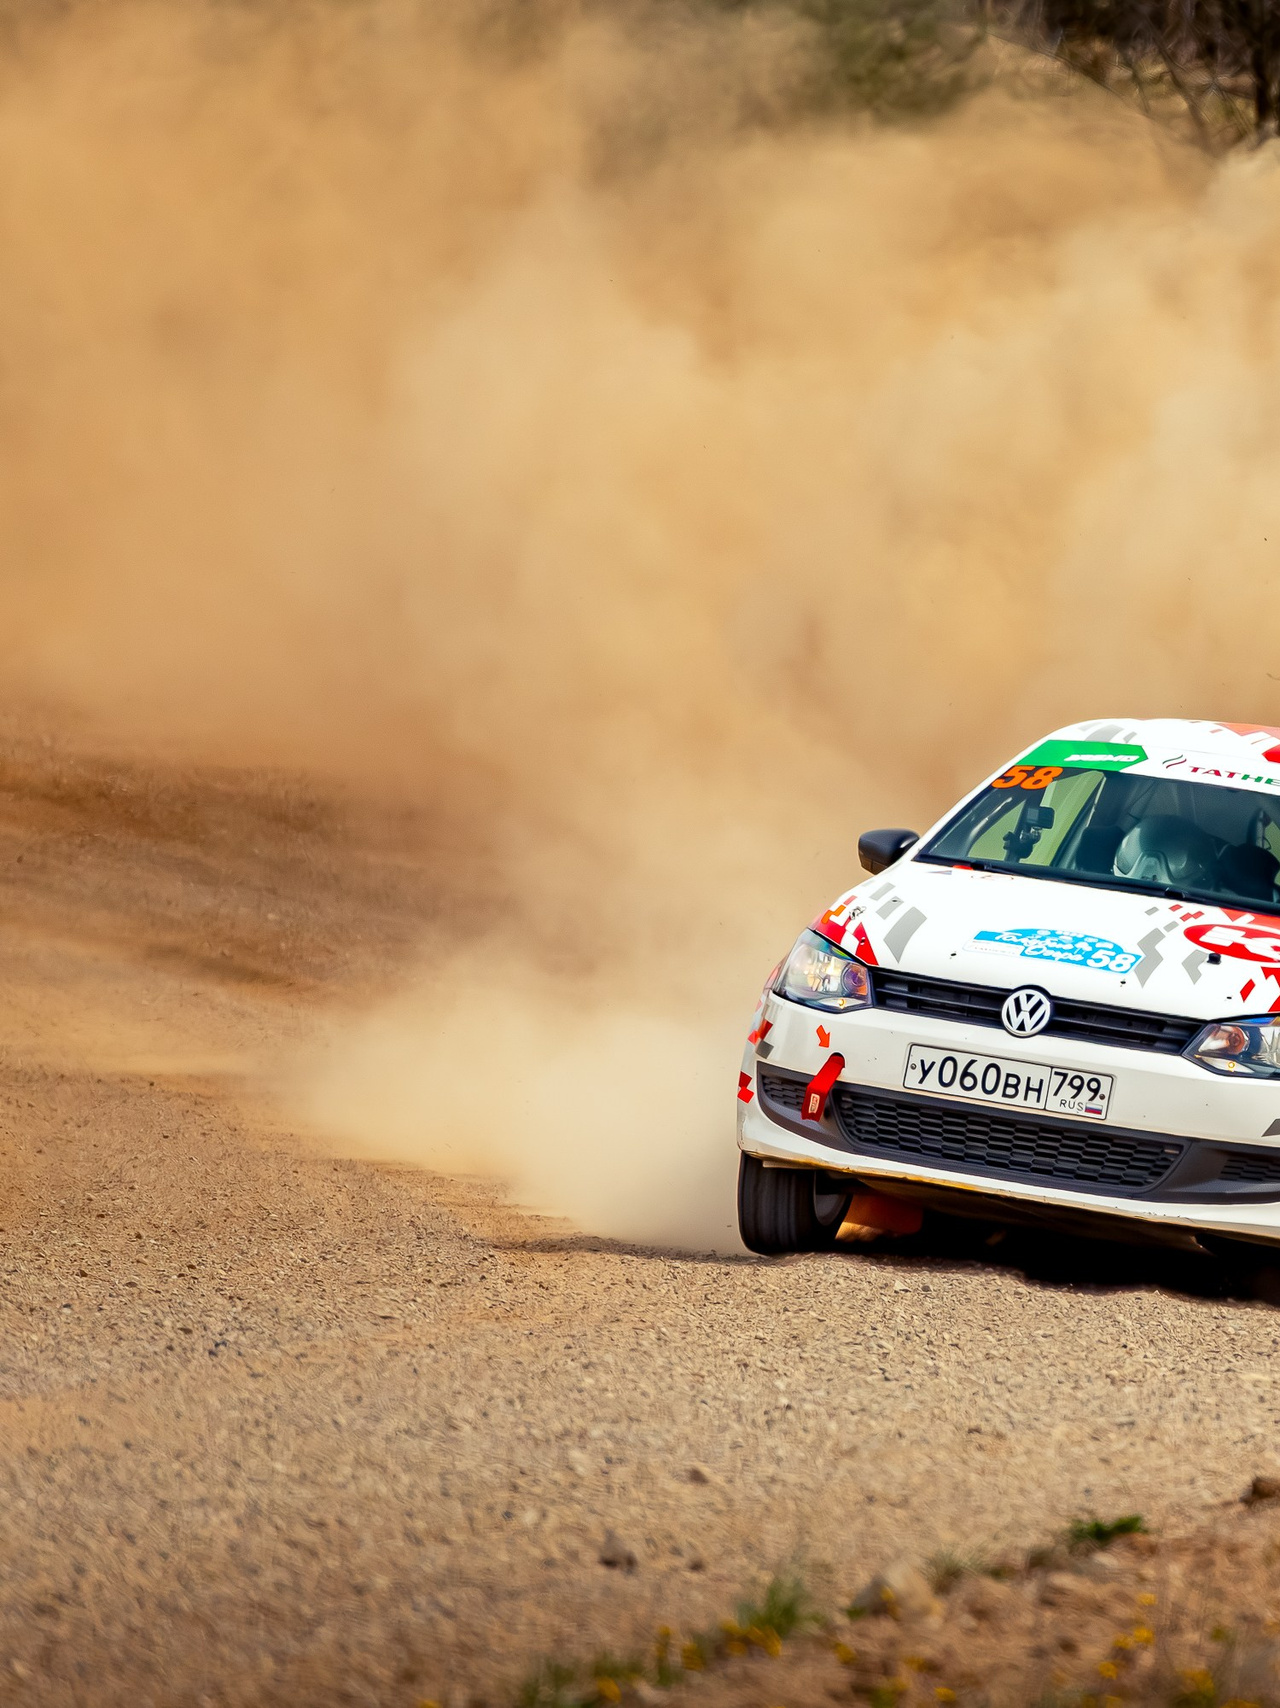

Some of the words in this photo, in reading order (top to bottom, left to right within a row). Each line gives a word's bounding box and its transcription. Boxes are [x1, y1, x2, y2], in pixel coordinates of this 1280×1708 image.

[991, 765, 1063, 790] 58
[1086, 950, 1136, 972] 58
[918, 1056, 1044, 1103] У060ВН
[1052, 1071, 1101, 1102] 799
[1059, 1099, 1084, 1112] RUS
